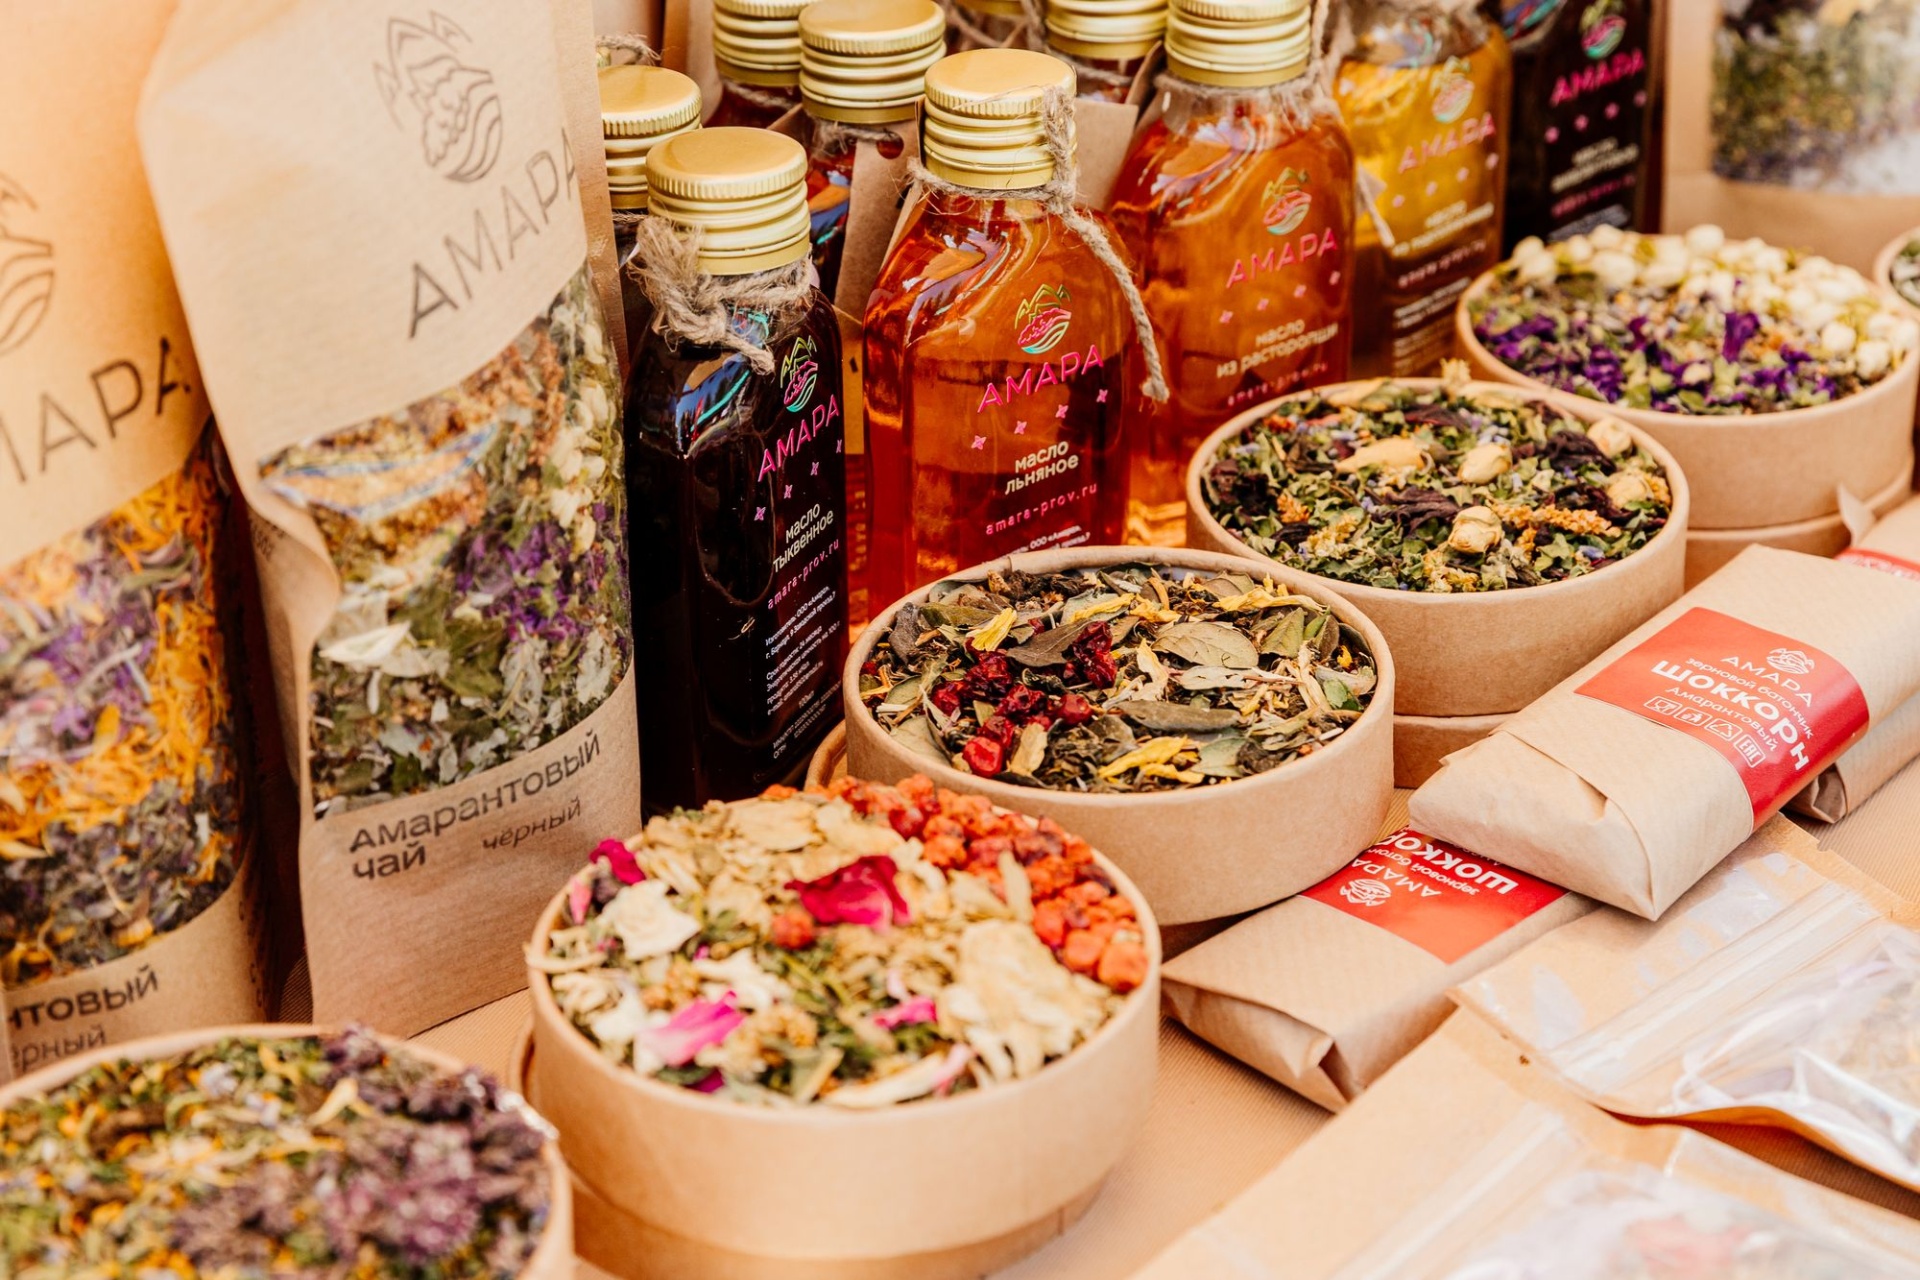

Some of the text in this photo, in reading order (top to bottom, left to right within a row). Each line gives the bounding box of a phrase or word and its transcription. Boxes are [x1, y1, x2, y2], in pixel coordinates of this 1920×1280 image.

[1398, 111, 1496, 174] АМАРА
[1226, 226, 1338, 288] АМАРА
[1255, 318, 1305, 347] масло
[977, 344, 1104, 413] АМАРА
[758, 394, 840, 483] АМАРА
[1015, 440, 1069, 474] масло
[1004, 454, 1080, 495] льняное
[785, 503, 820, 544] масло
[985, 482, 1098, 535] amara-prov.ru
[773, 510, 834, 573] тыквенное
[767, 538, 839, 610] amara-prov.ru
[1685, 657, 1815, 740] зерновой батончик
[1720, 655, 1813, 708] АМАРА
[1665, 686, 1779, 752] Амарантовый
[349, 728, 600, 853] Амарантовый
[353, 841, 426, 880] чай
[1351, 858, 1442, 898] АМАРА
[1410, 863, 1480, 896] зерновой
